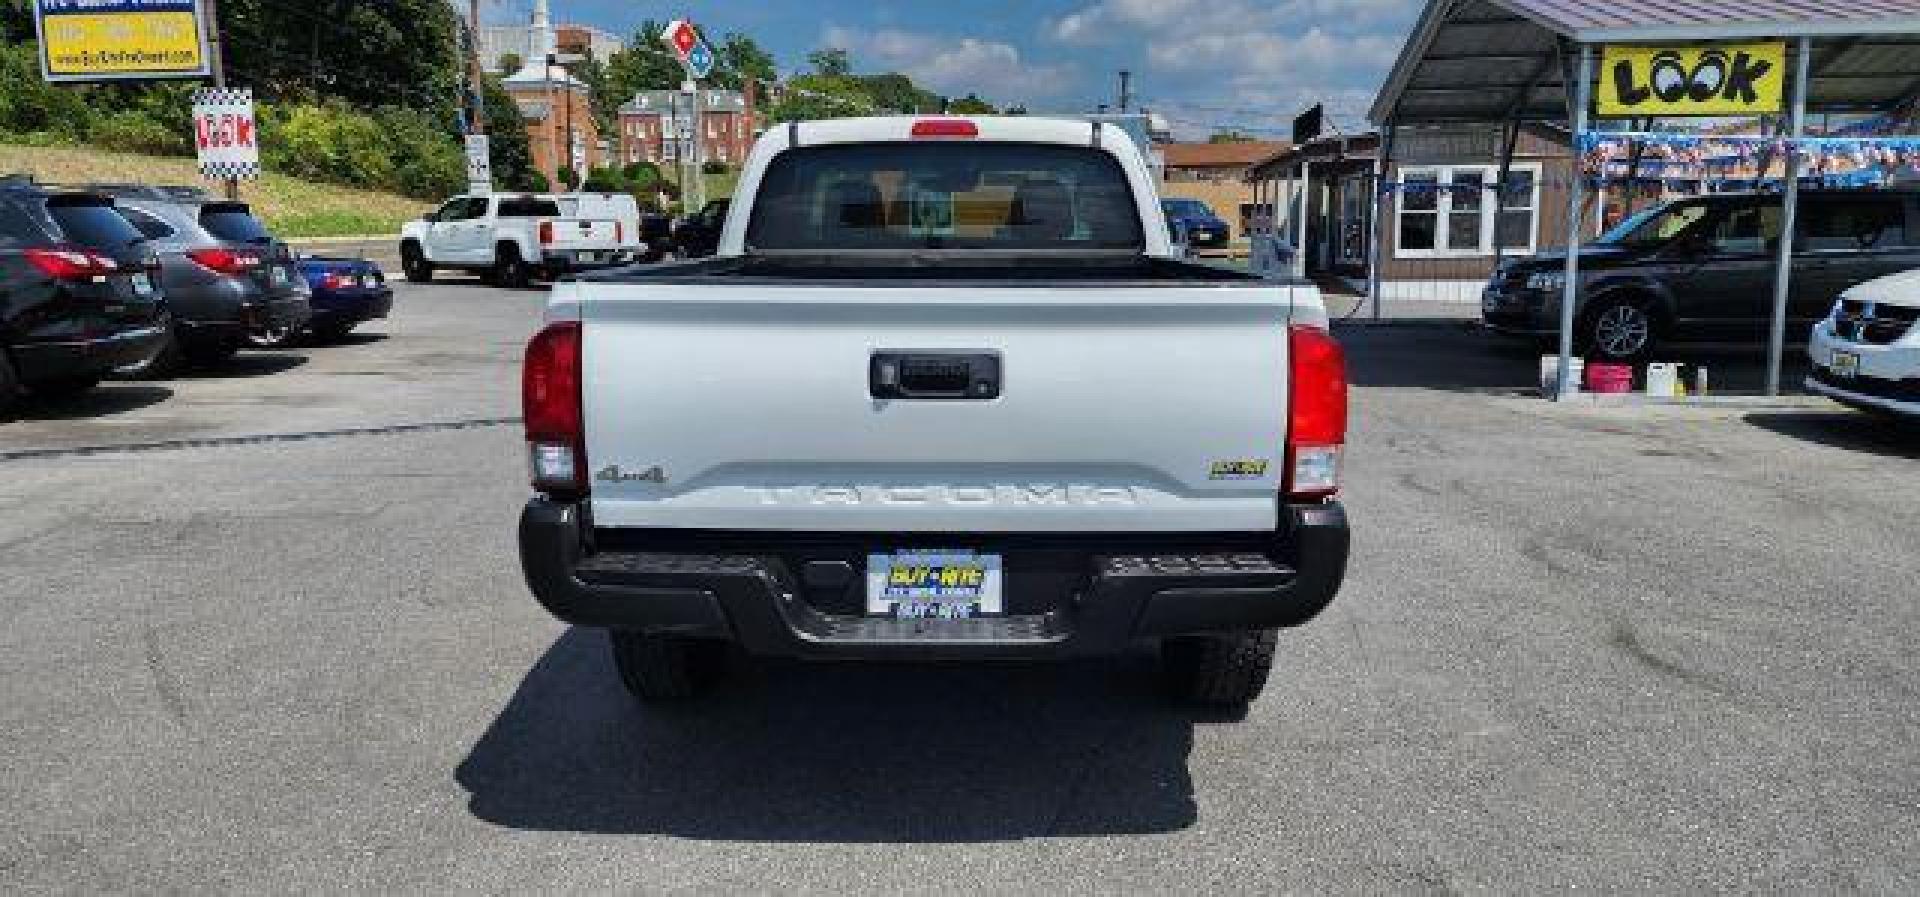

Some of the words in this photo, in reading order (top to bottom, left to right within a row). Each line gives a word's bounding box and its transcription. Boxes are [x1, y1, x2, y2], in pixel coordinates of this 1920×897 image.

[1613, 50, 1774, 105] LOOK
[195, 113, 254, 149] LOOK
[744, 483, 1139, 505] TACOMA
